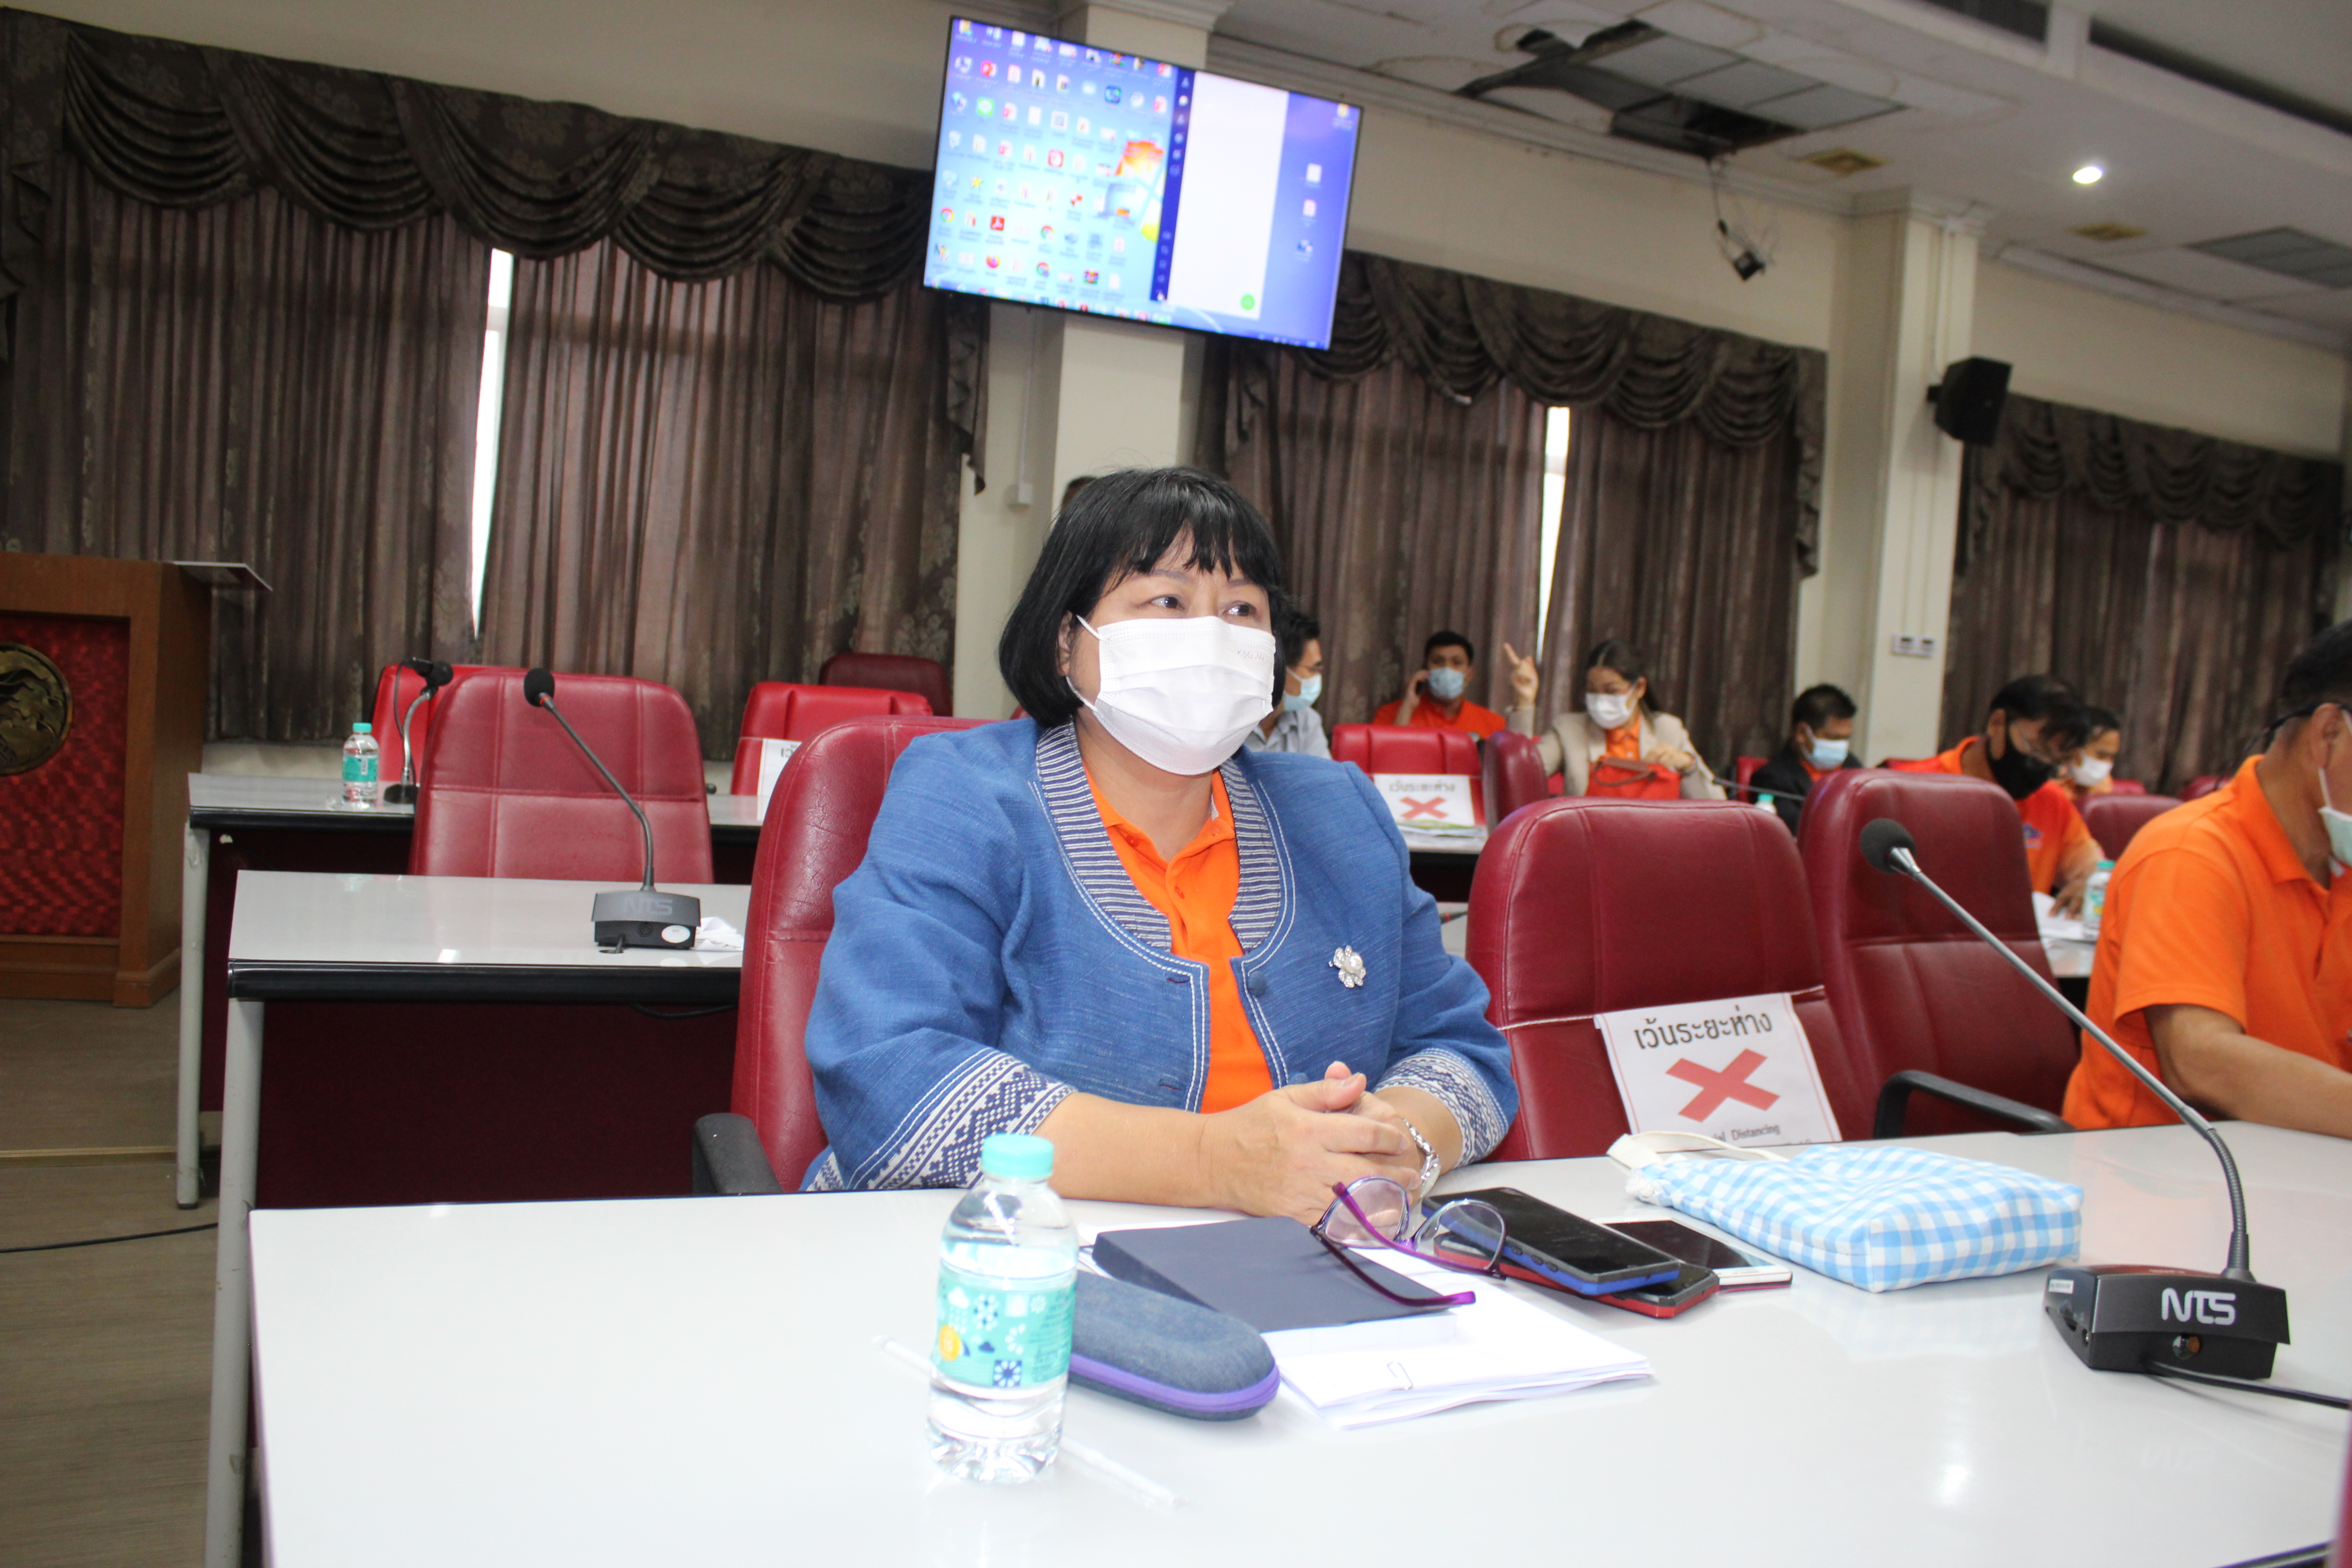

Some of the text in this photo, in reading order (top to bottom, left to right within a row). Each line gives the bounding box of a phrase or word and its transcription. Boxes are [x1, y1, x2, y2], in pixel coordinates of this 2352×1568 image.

[1634, 1005, 1772, 1049] เว้นระยะห่าง
[1731, 1124, 1781, 1140] Distancing
[2161, 1287, 2236, 1325] NTS
